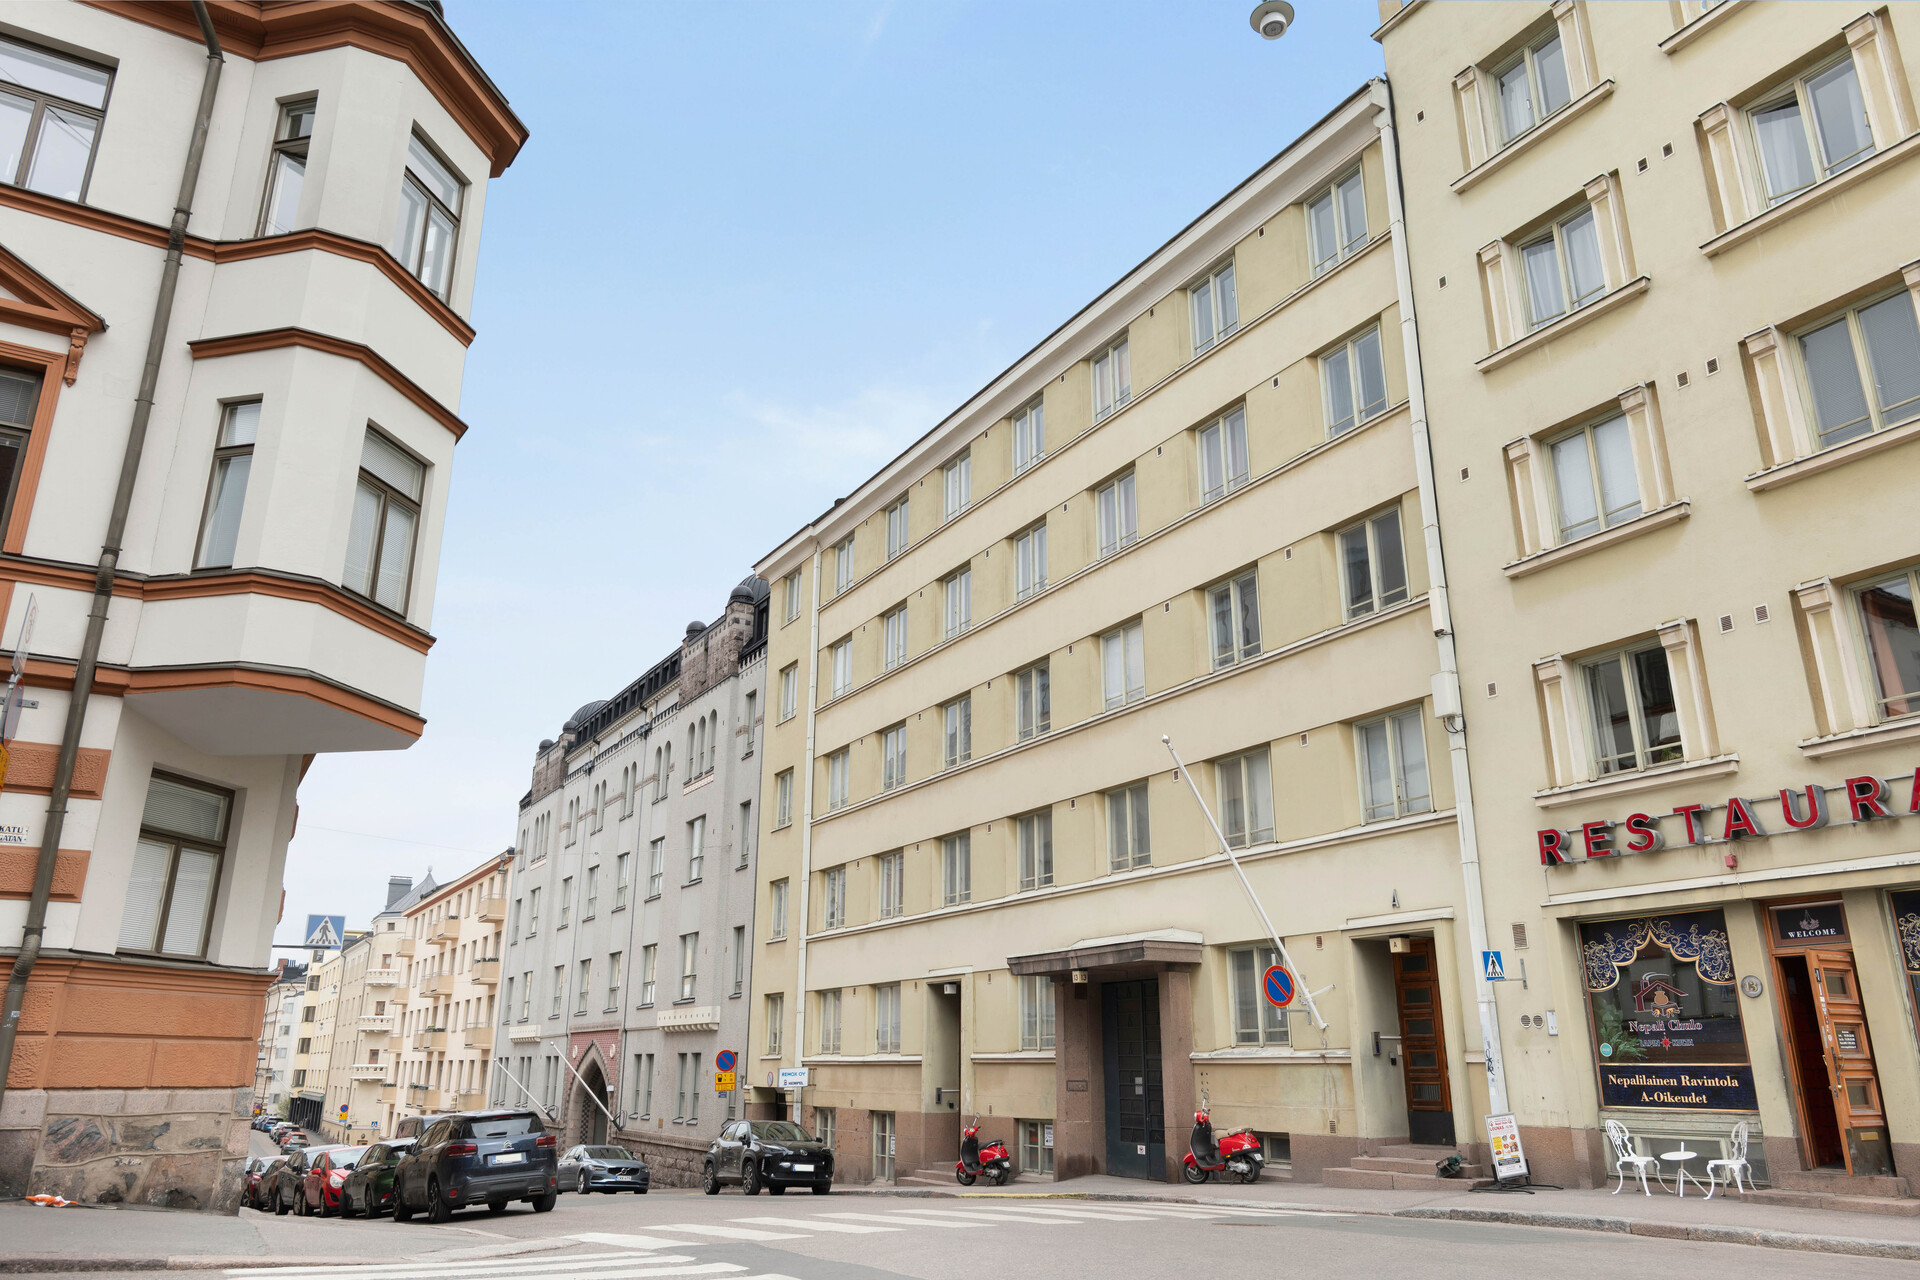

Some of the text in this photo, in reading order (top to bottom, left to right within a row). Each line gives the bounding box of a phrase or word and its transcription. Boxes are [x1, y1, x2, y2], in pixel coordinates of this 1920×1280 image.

[1537, 766, 1920, 865] RESTAUR
[1391, 889, 1400, 908] A
[1788, 928, 1837, 938] WELCOME
[1745, 980, 1758, 992] 13
[1628, 1019, 1703, 1034] Nepali Chulo
[1608, 1074, 1739, 1088] Nepalilainen Ravintola
[1640, 1091, 1708, 1104] A-Oikeudet
